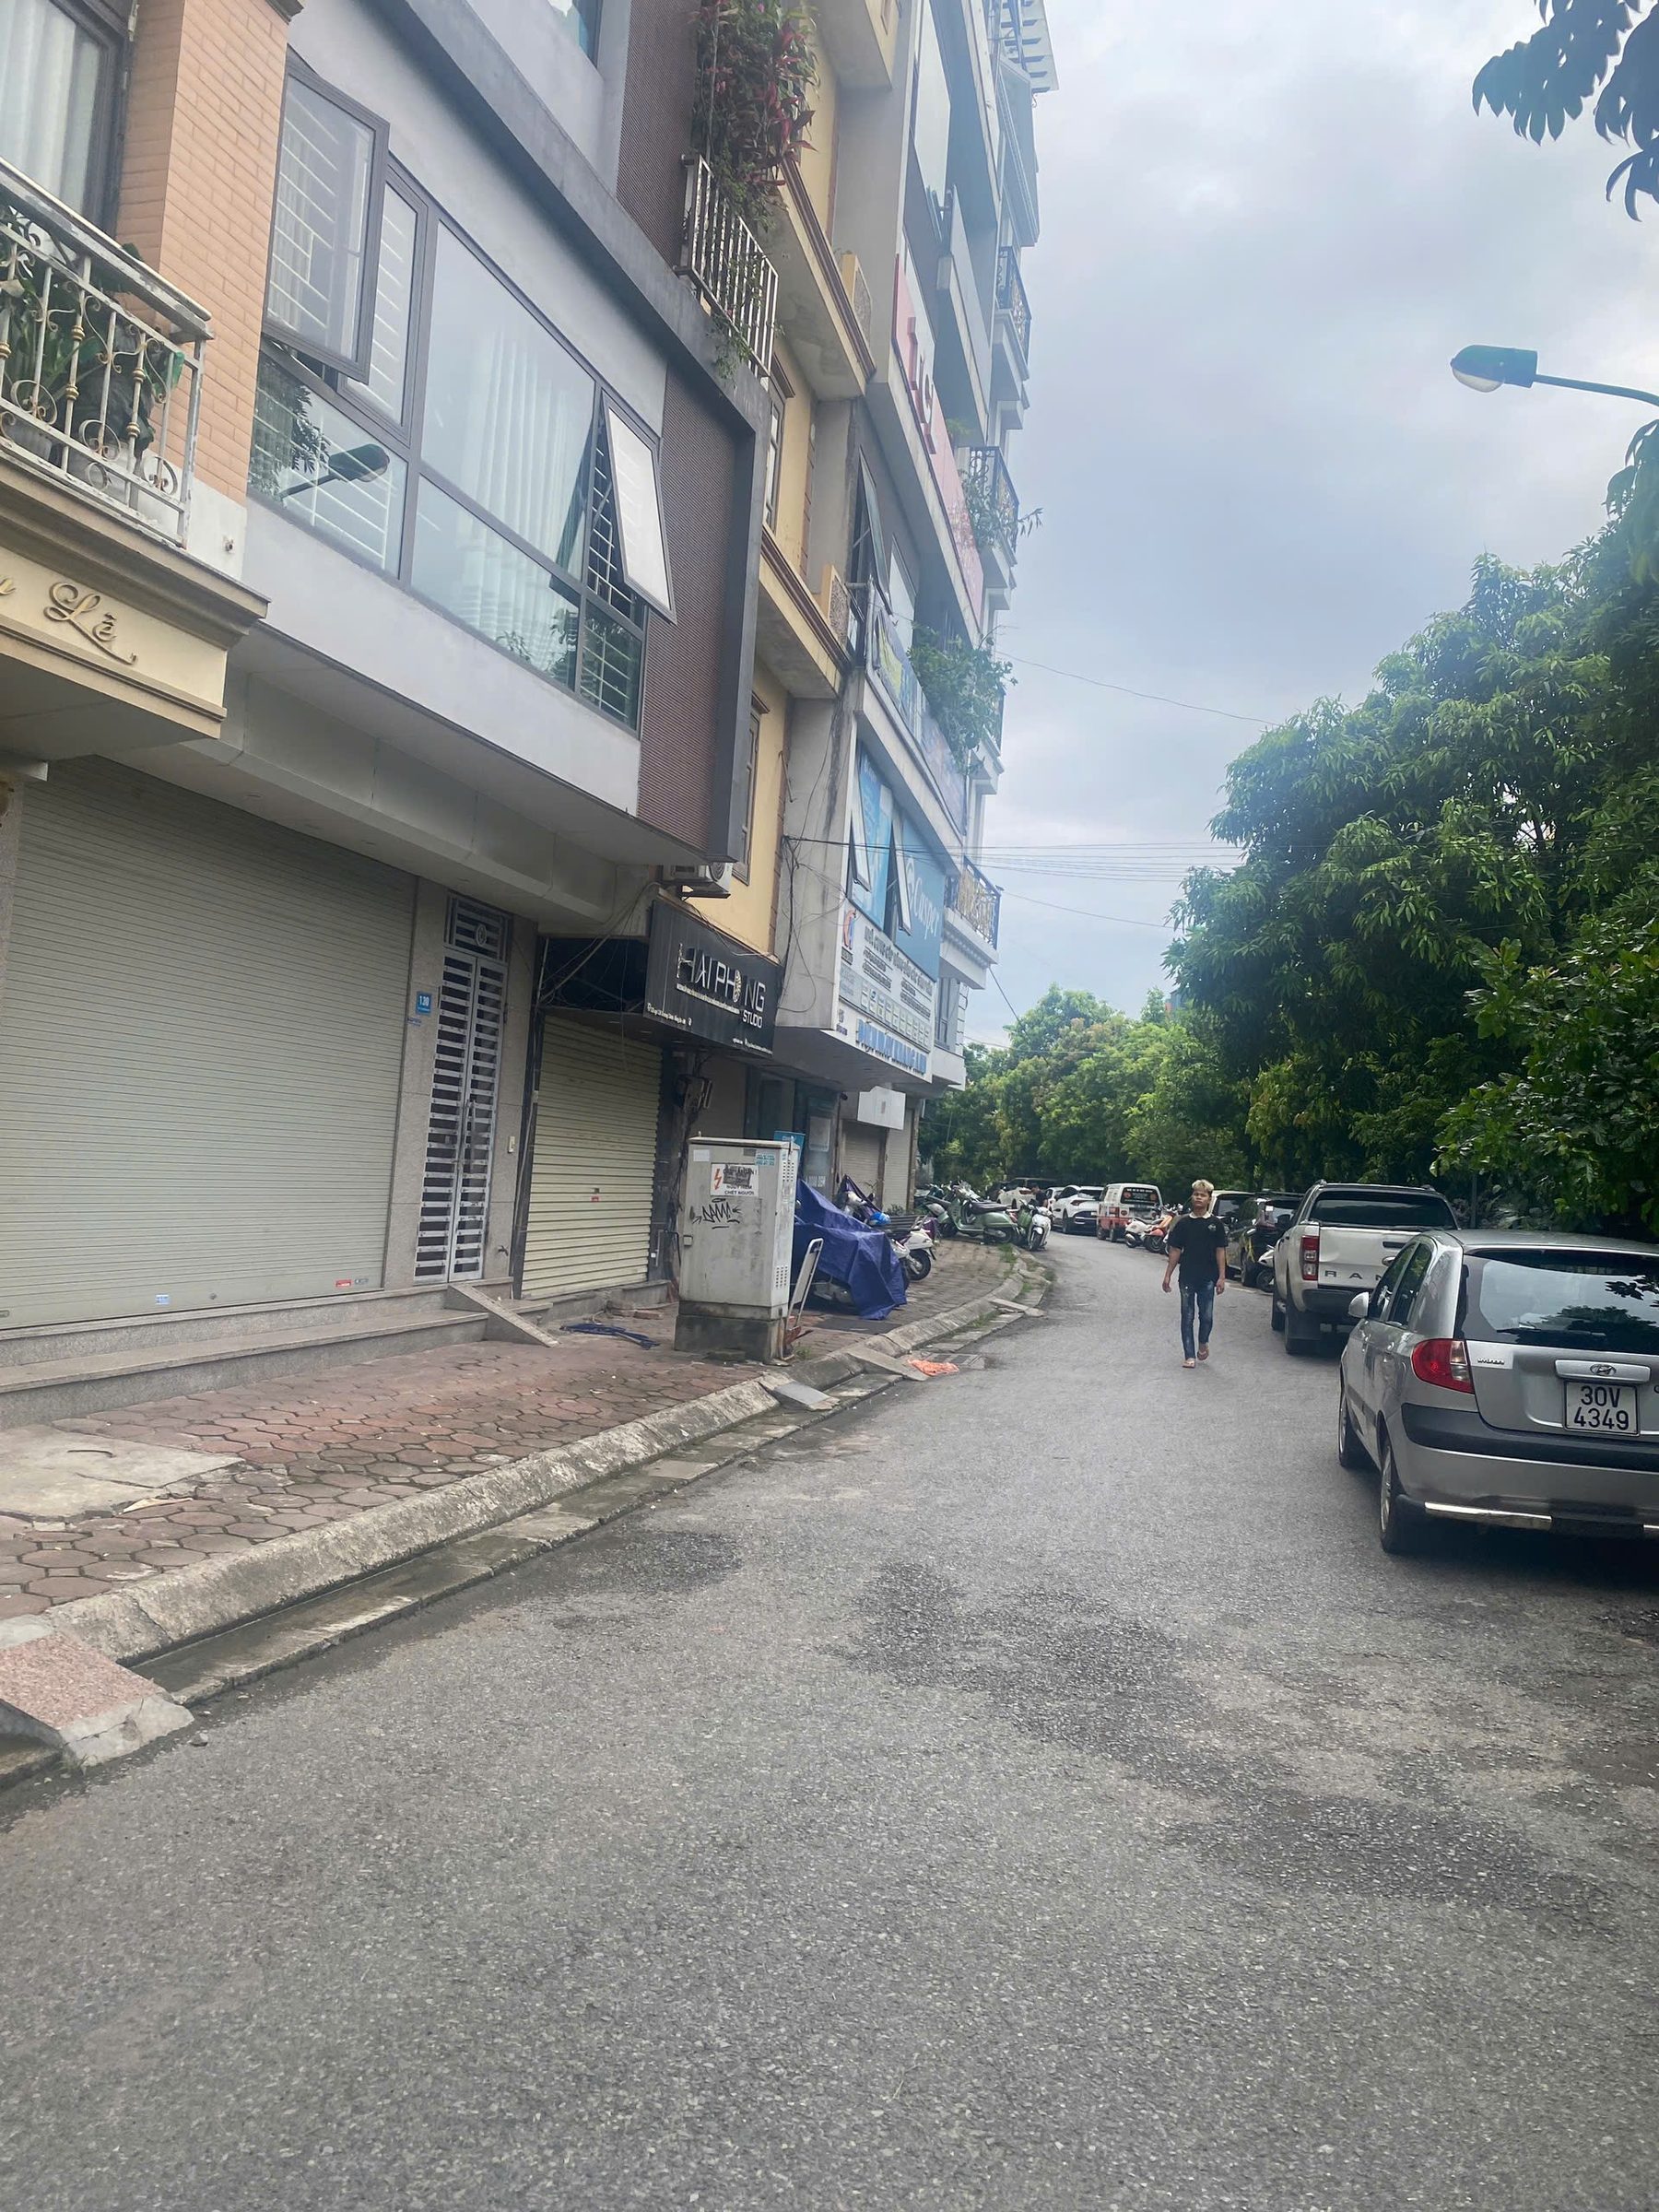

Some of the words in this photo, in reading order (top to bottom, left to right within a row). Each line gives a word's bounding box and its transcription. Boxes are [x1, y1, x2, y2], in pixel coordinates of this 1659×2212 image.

[742, 1009, 763, 1029] STUDIO
[1580, 1385, 1620, 1408] 30V
[1573, 1406, 1630, 1430] 4349
